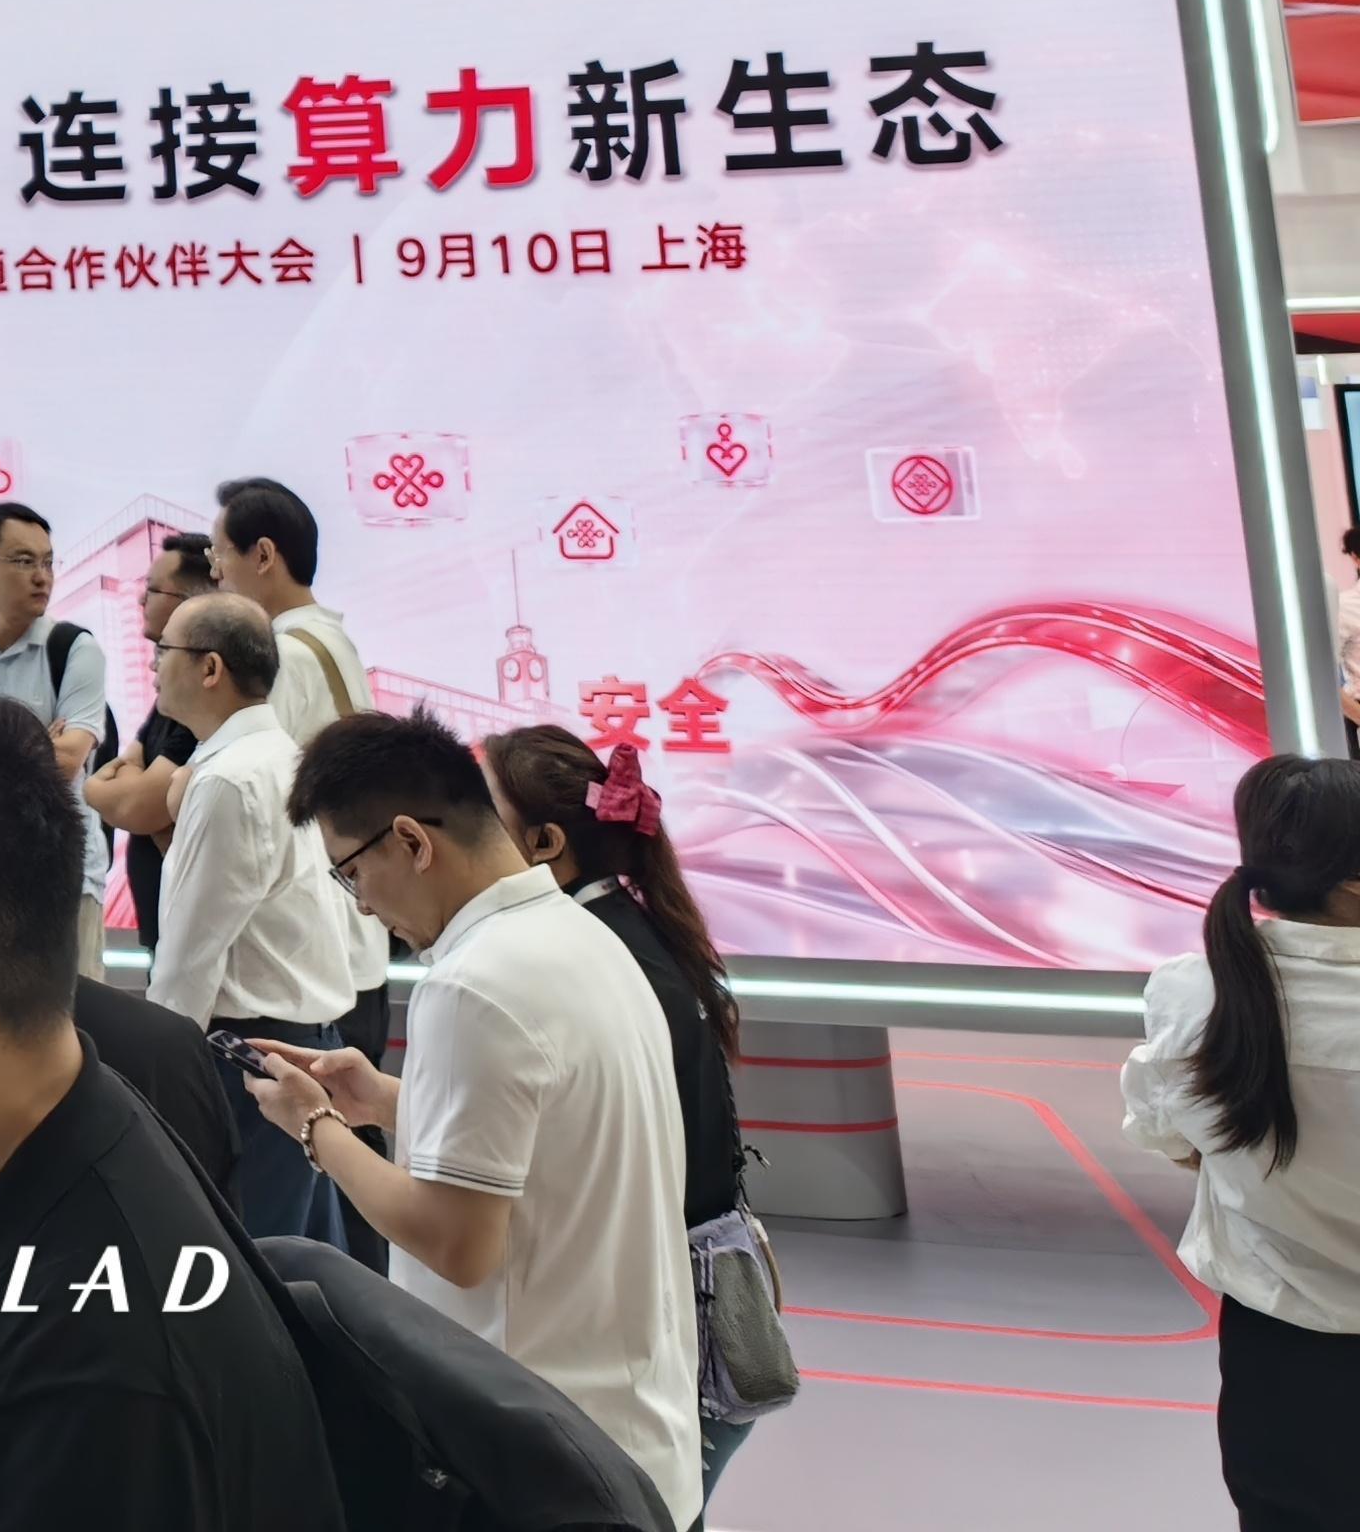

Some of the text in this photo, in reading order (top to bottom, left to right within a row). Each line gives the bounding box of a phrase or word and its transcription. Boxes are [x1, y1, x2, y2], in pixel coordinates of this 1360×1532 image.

[19, 41, 1003, 205] 连接算力新生态
[396, 228, 611, 278] 9月10日
[641, 223, 748, 272] 上海
[577, 675, 732, 755] 安全
